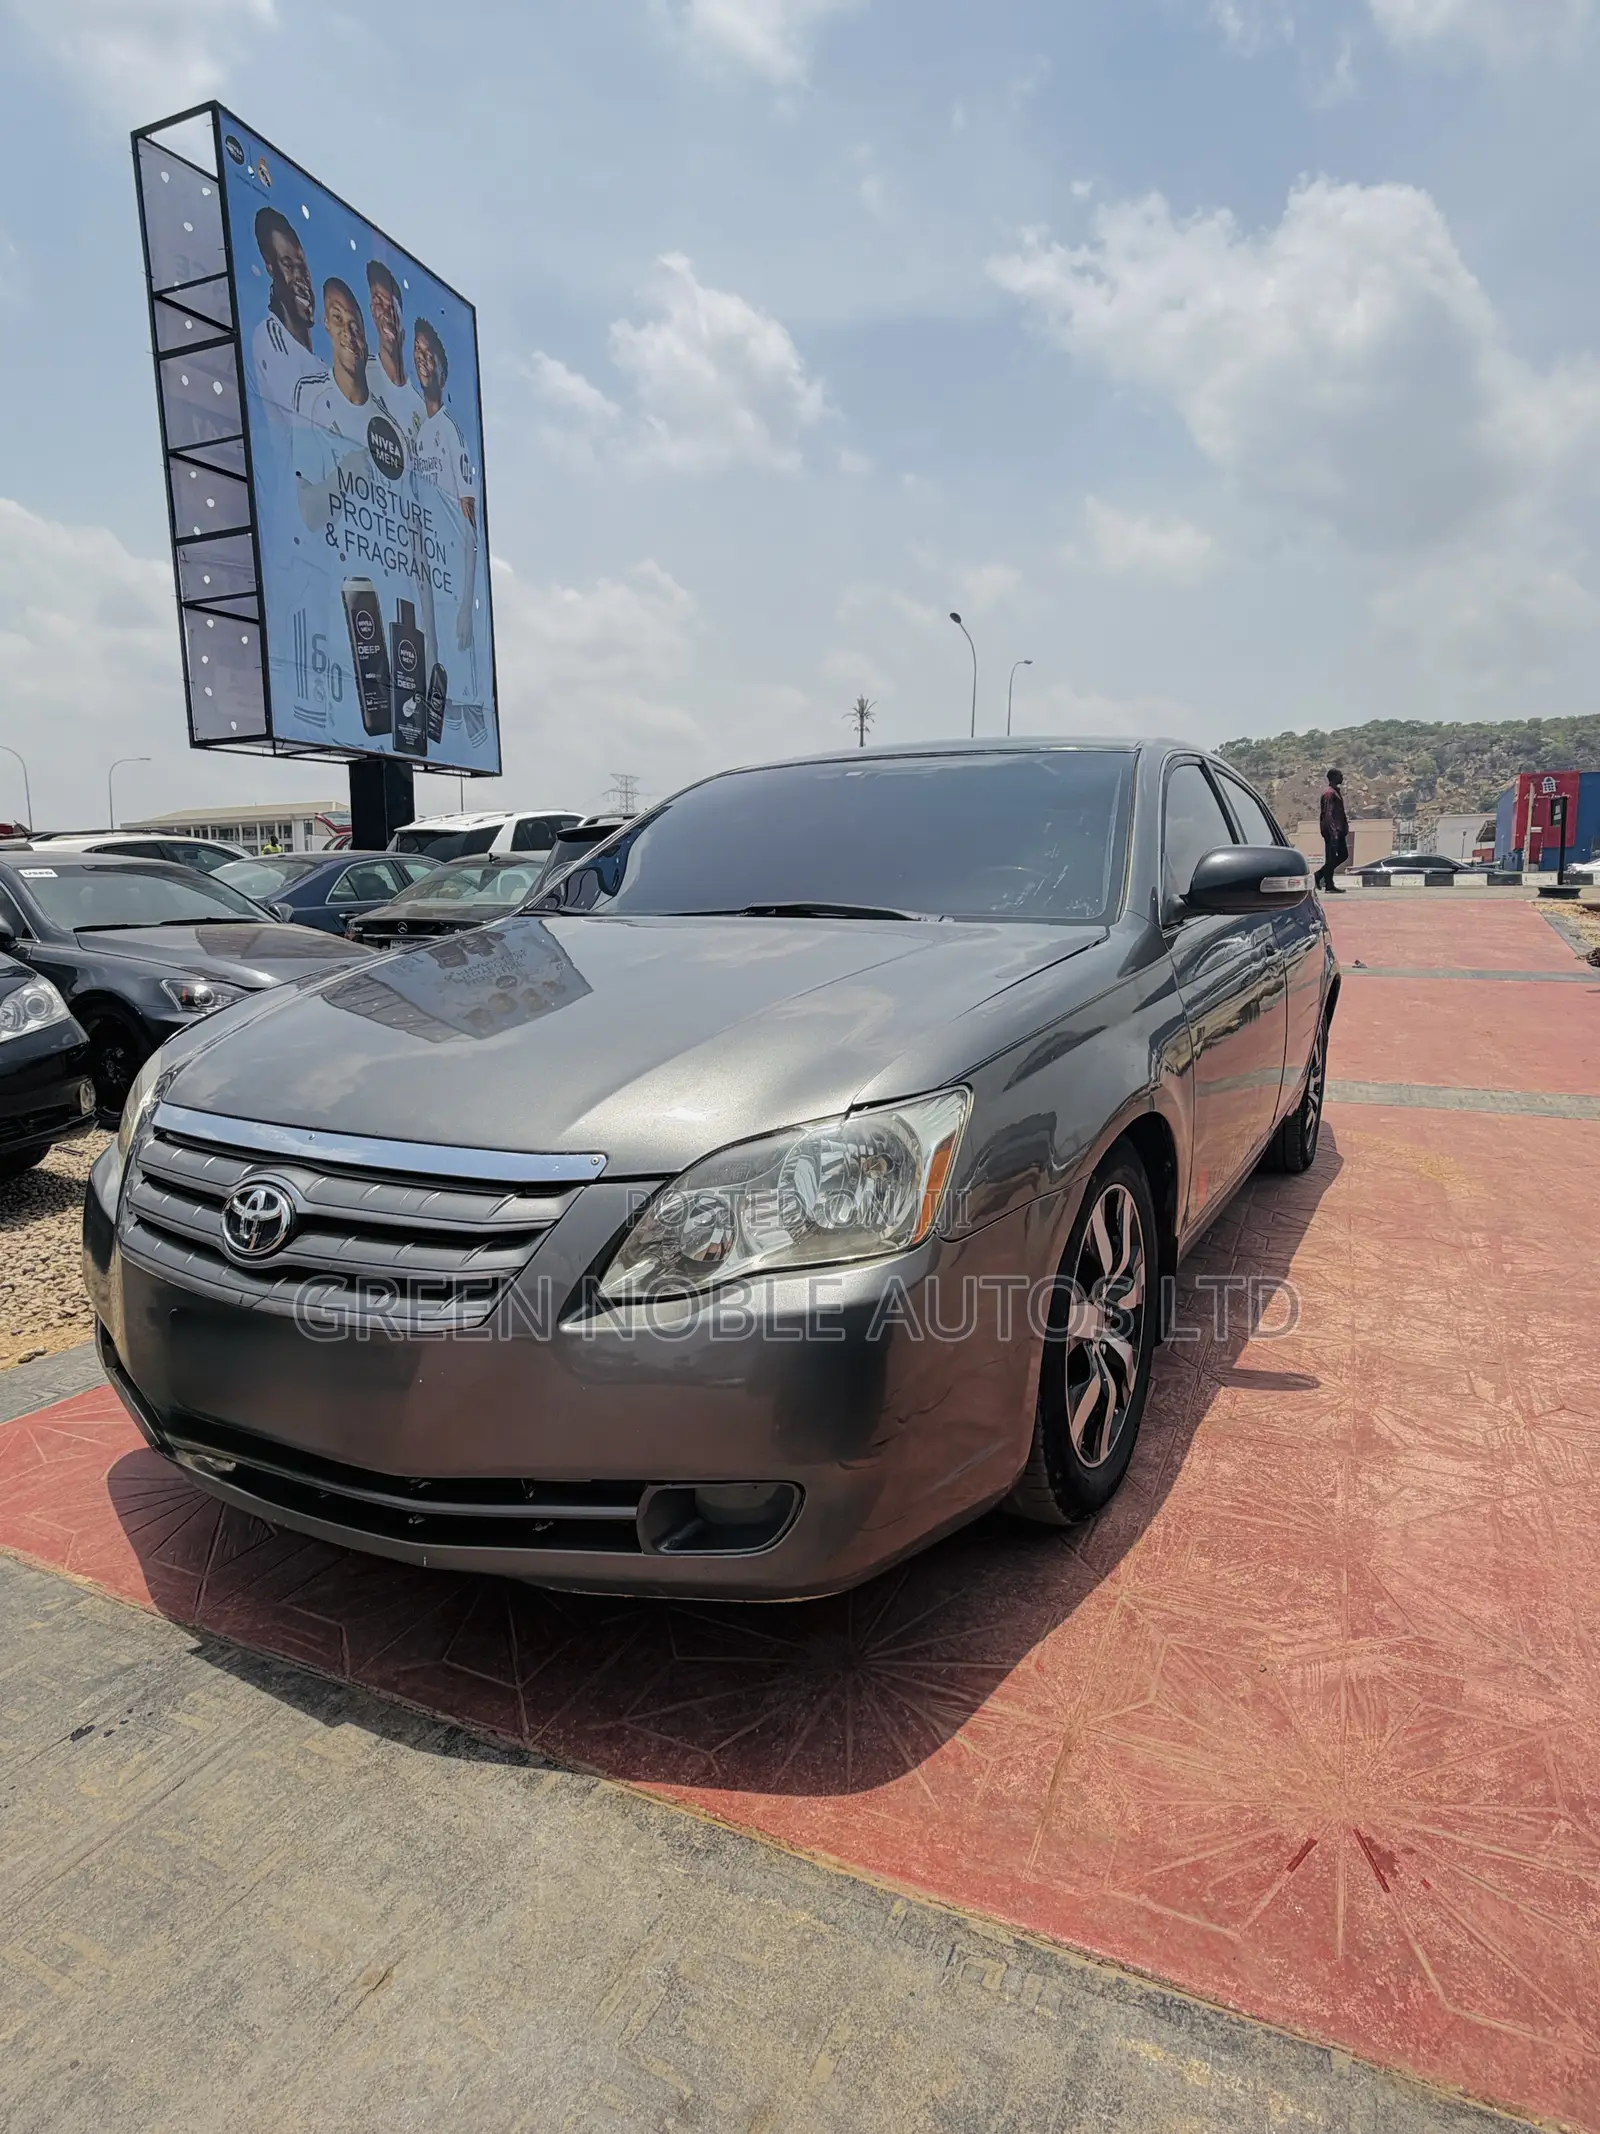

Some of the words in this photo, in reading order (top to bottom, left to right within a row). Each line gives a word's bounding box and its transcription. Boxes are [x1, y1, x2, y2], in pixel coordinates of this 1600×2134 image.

[370, 431, 401, 458] NIVEA
[376, 448, 399, 469] MEN
[337, 466, 438, 539] MOISTURE,
[329, 493, 447, 565] PROTECTION
[325, 522, 339, 548] &
[344, 529, 453, 594] FRAGRANCE
[357, 645, 380, 654] DEEP
[397, 680, 416, 690] DEEP
